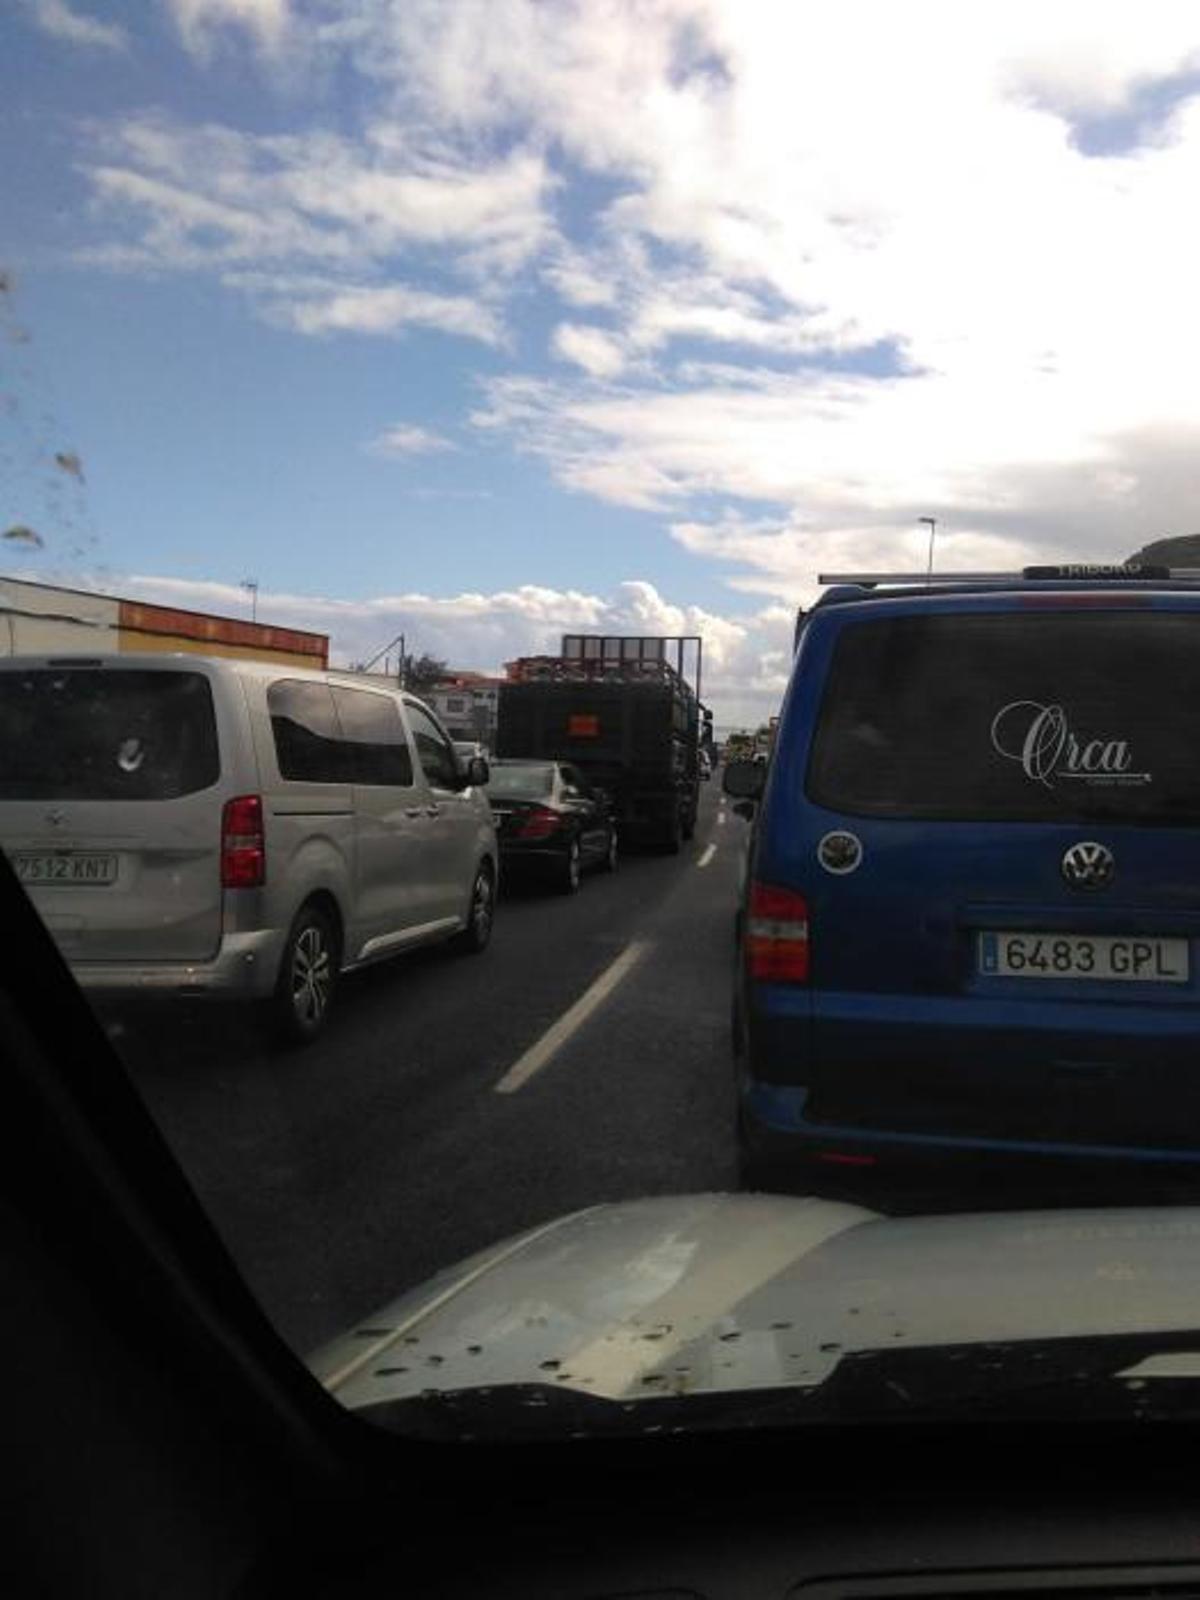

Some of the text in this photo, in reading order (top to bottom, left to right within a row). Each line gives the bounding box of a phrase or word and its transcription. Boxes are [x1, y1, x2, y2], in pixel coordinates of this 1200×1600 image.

[991, 700, 1132, 789] Orca
[20, 858, 110, 878] 7512 KNT
[1006, 939, 1179, 976] 6483 GPL
